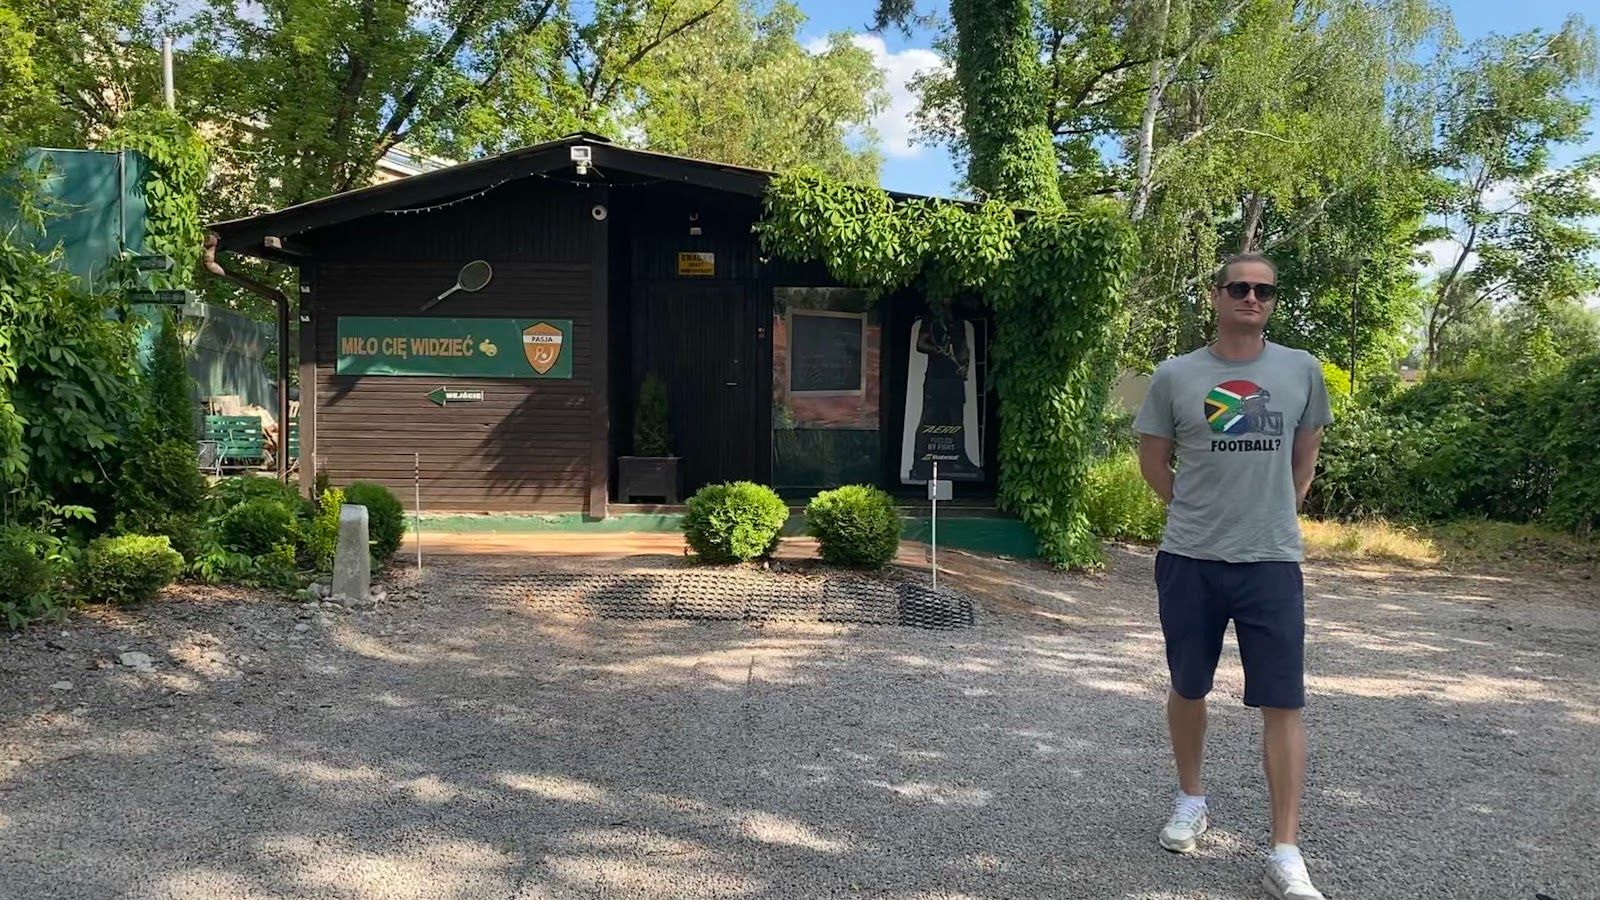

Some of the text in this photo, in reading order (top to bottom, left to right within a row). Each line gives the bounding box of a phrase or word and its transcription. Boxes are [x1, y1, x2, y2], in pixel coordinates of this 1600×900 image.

[341, 334, 474, 360] MIŁO CIĘ WIDZIEĆ
[921, 425, 962, 434] AERO
[1211, 439, 1281, 452] FOOTBALL?
